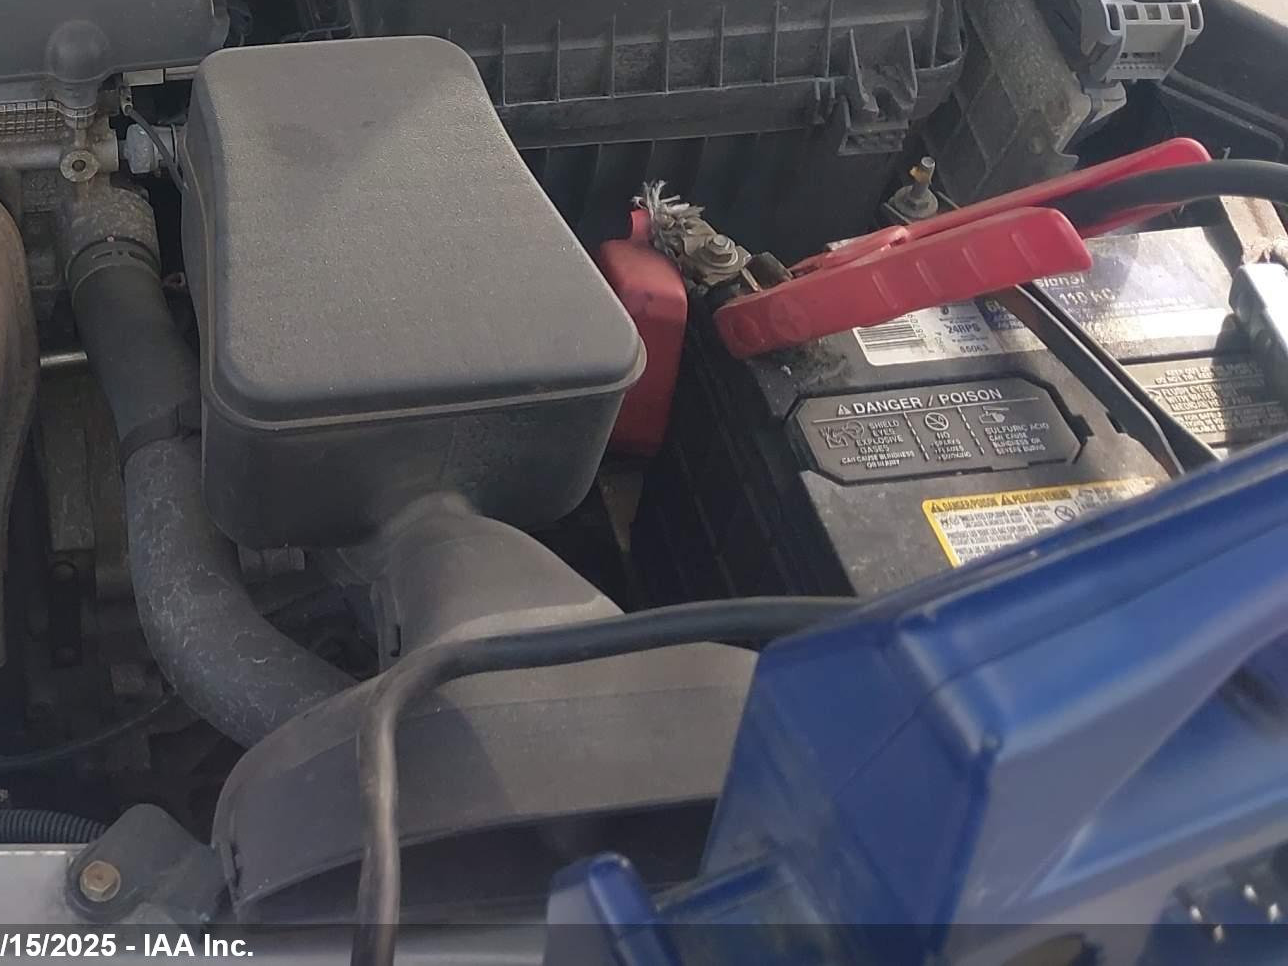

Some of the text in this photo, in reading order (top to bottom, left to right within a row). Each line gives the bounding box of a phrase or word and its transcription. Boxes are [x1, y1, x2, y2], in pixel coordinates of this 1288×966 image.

[853, 388, 1003, 414] DANGER / POISON
[869, 420, 900, 429] SHIELD
[856, 435, 904, 447] EXPLOSIVE
